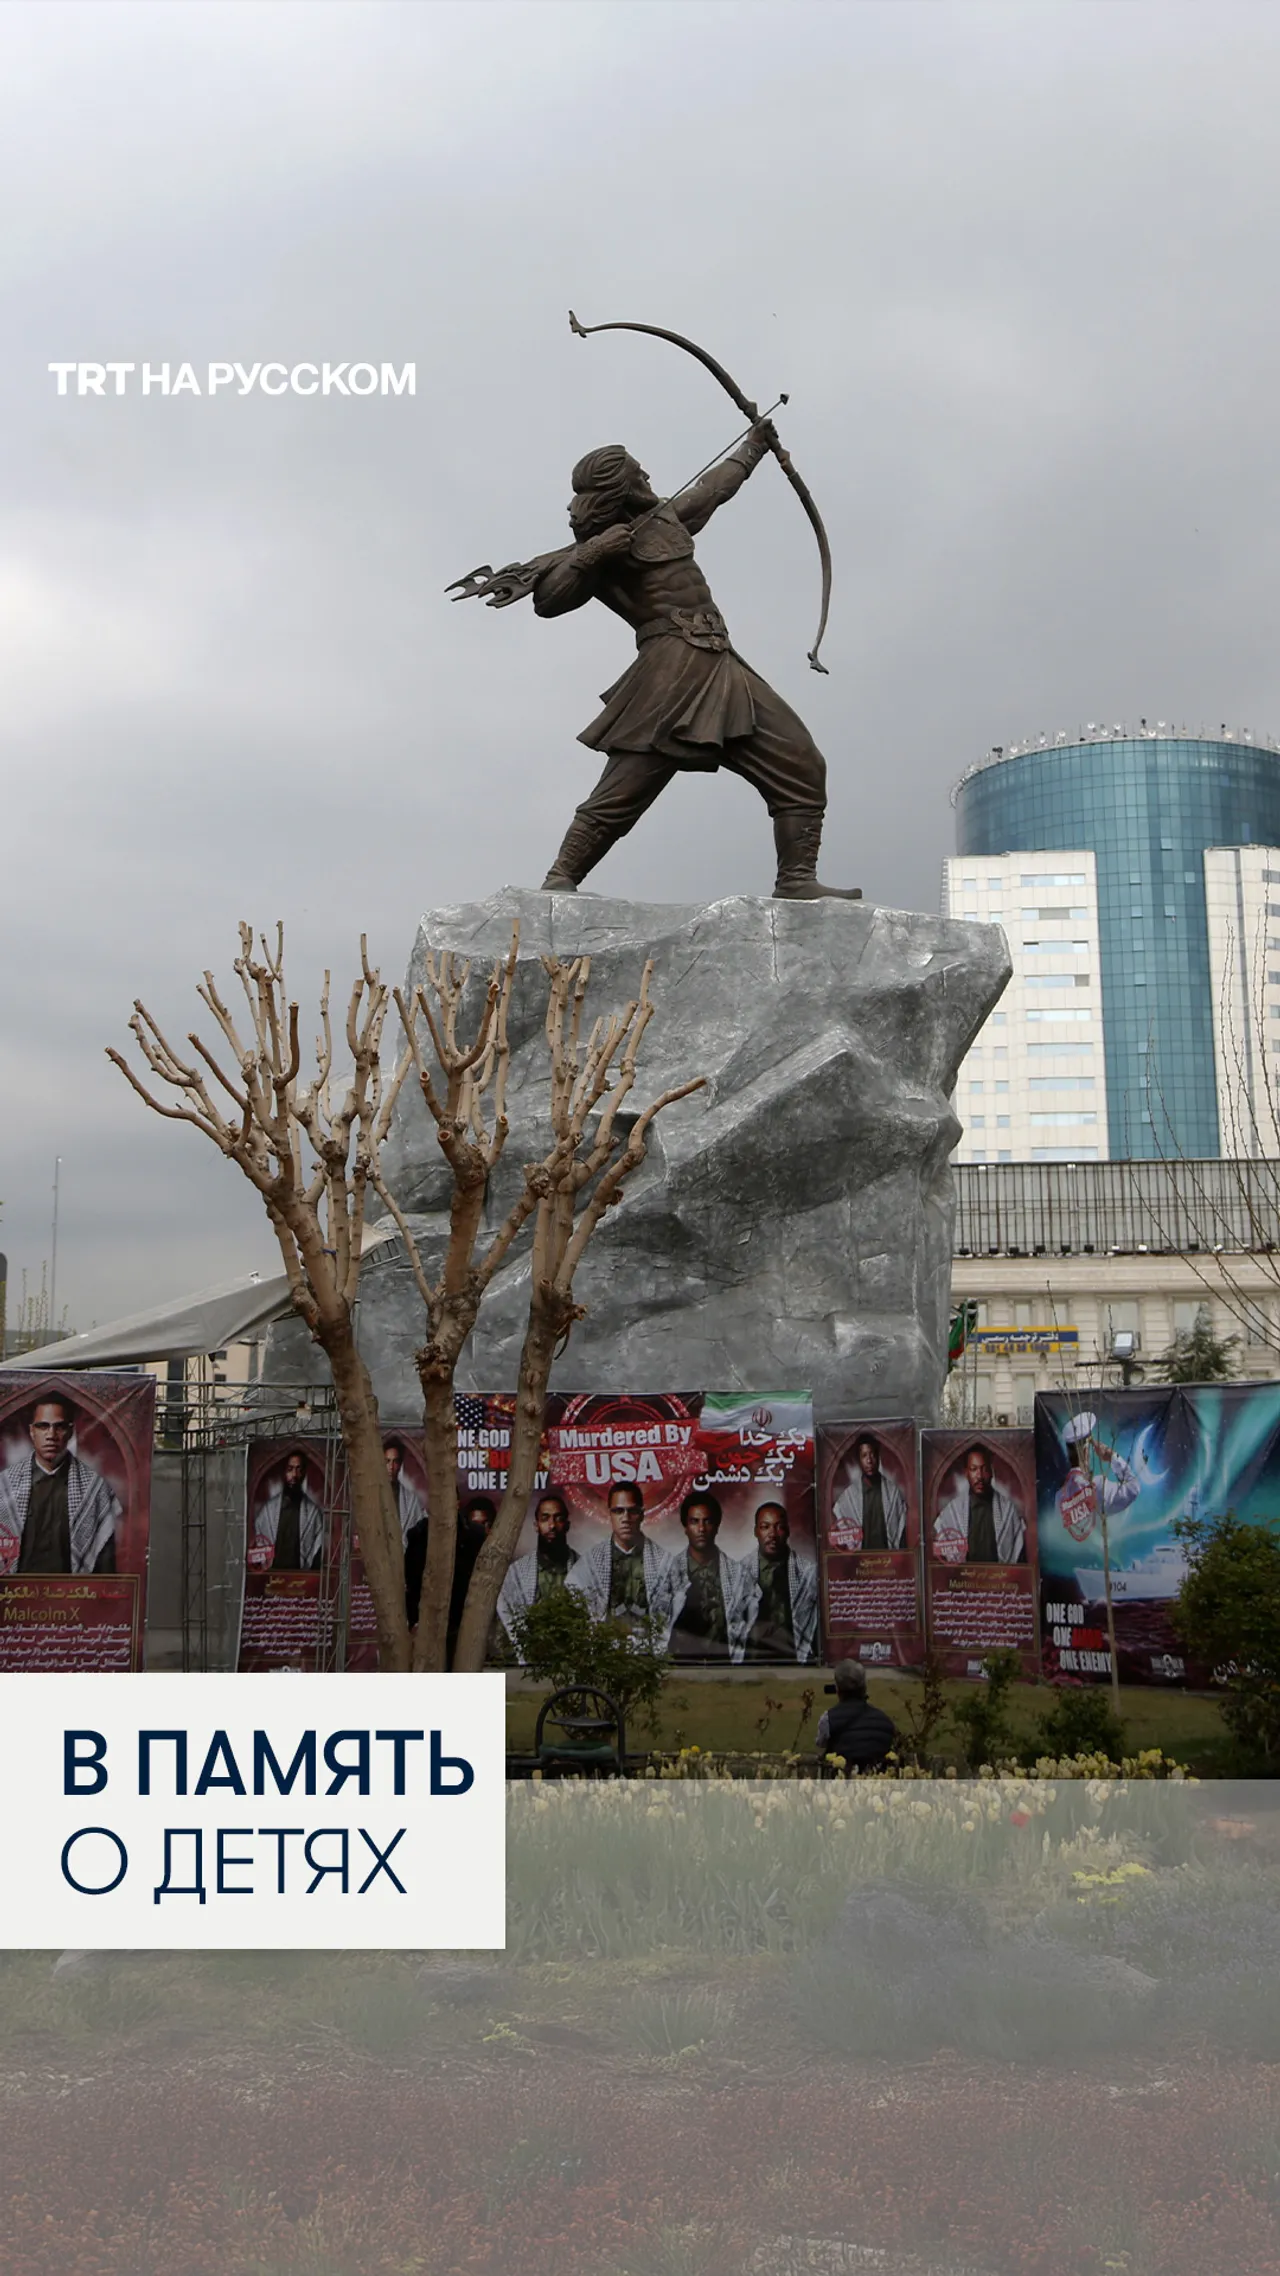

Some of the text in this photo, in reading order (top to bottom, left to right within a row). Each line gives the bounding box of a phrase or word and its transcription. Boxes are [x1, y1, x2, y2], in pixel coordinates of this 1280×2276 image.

[457, 1429, 510, 1448] NE GOD
[558, 1423, 692, 1449] Murdered By
[739, 1426, 773, 1447] خدا
[457, 1450, 486, 1469] ONE
[585, 1450, 664, 1485] USA
[715, 1450, 761, 1470] خون
[467, 1471, 496, 1490] ONE
[692, 1464, 752, 1491] دشمن
[1070, 1502, 1090, 1524] USA
[837, 1535, 855, 1544] USA
[941, 1546, 959, 1555] USA
[3, 1605, 81, 1621] Malcolm X
[1045, 1602, 1085, 1625] ONE GOD
[1053, 1626, 1072, 1648] ONE
[1059, 1649, 1112, 1673] ONE ENEMY
